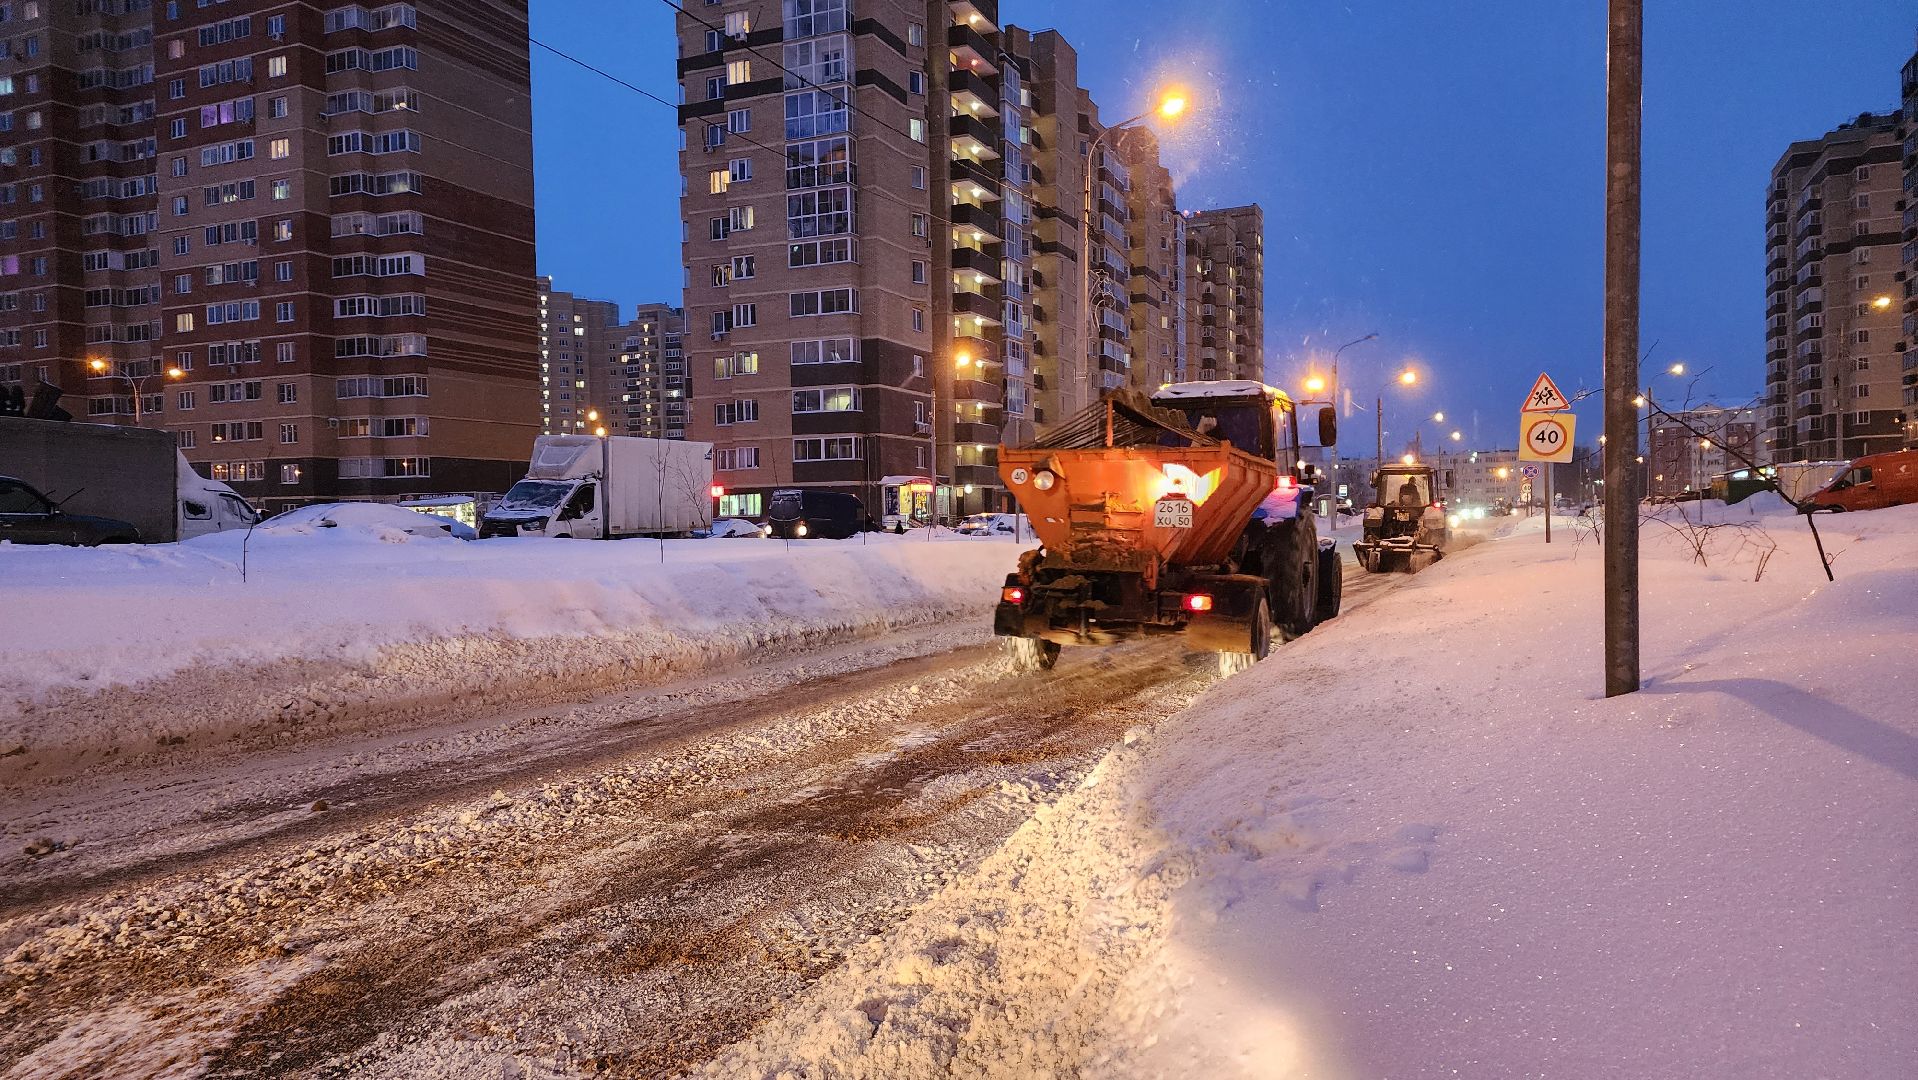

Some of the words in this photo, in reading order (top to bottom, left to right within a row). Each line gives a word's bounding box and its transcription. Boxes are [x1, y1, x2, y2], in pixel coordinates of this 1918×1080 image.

[1535, 430, 1559, 443] 40
[1014, 471, 1026, 481] 40
[1159, 502, 1189, 513] 2616
[1178, 516, 1190, 526] 50
